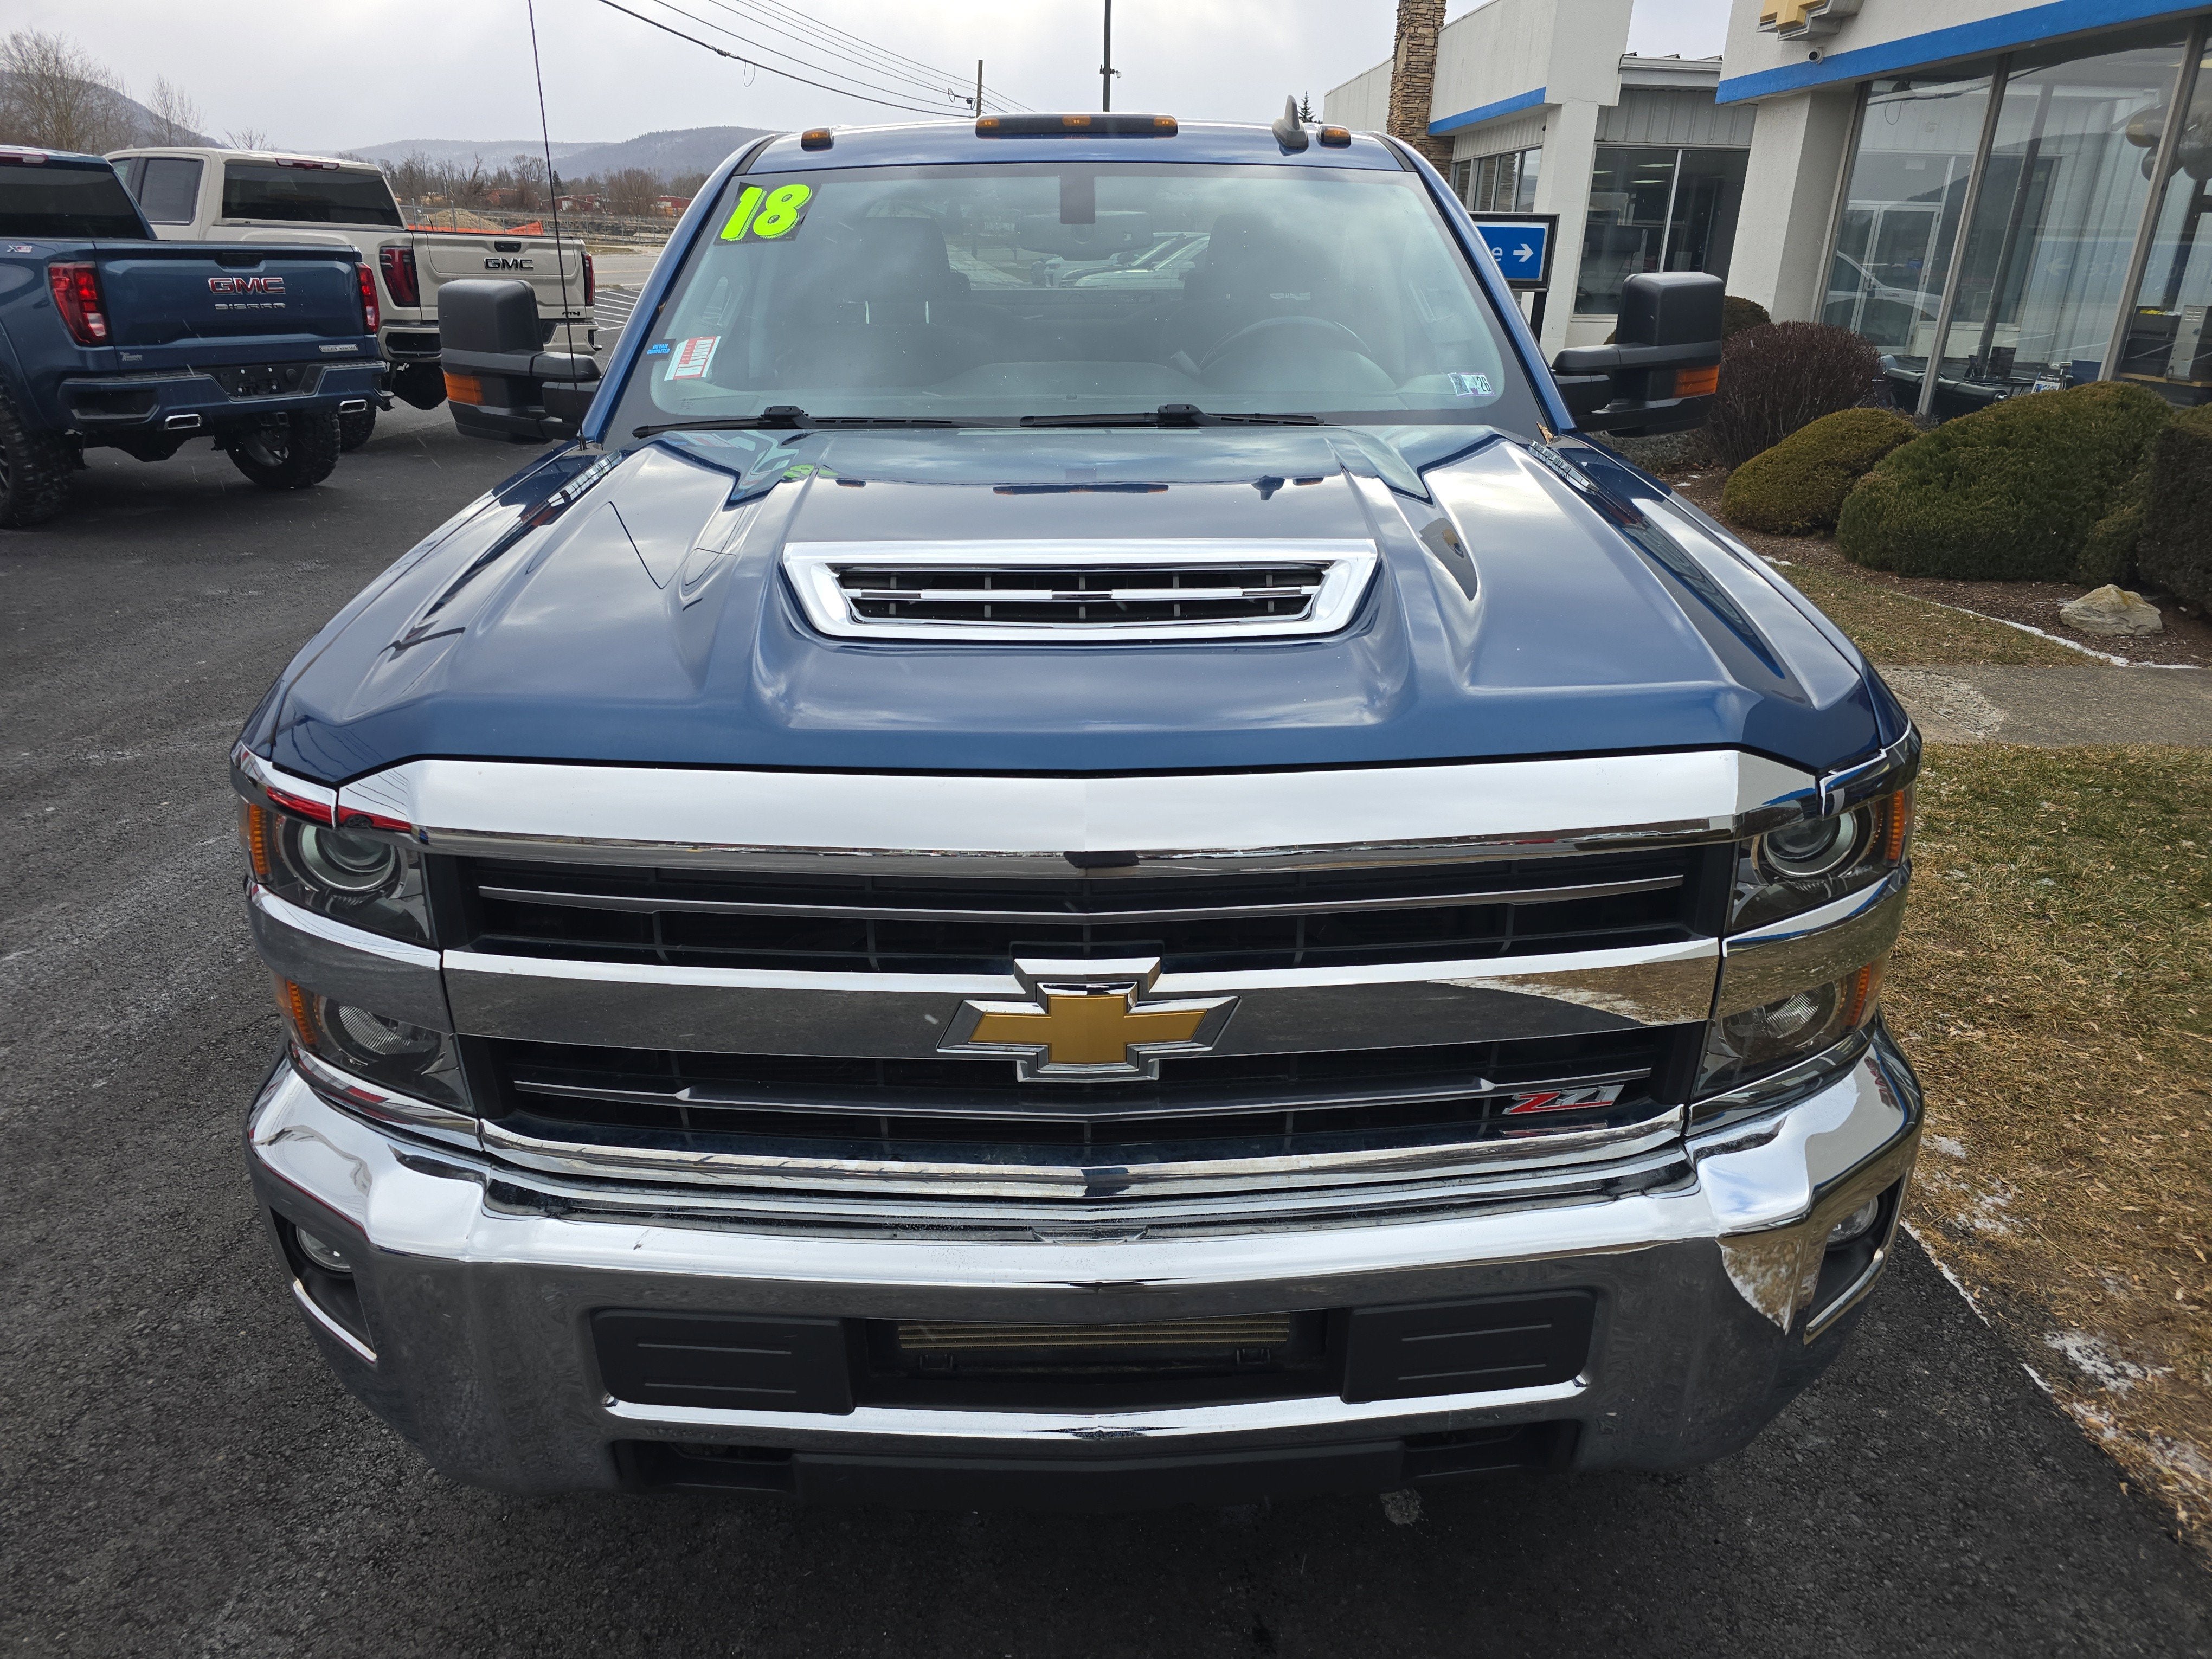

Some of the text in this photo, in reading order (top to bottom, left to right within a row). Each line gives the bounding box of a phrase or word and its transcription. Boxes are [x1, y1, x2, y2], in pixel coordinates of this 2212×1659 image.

[720, 184, 813, 241] 18
[484, 257, 534, 270] GMC
[208, 277, 286, 295] GMC
[215, 303, 286, 311] SIERRA
[1476, 376, 1491, 392] 26
[1501, 1085, 1624, 1115] Z71
